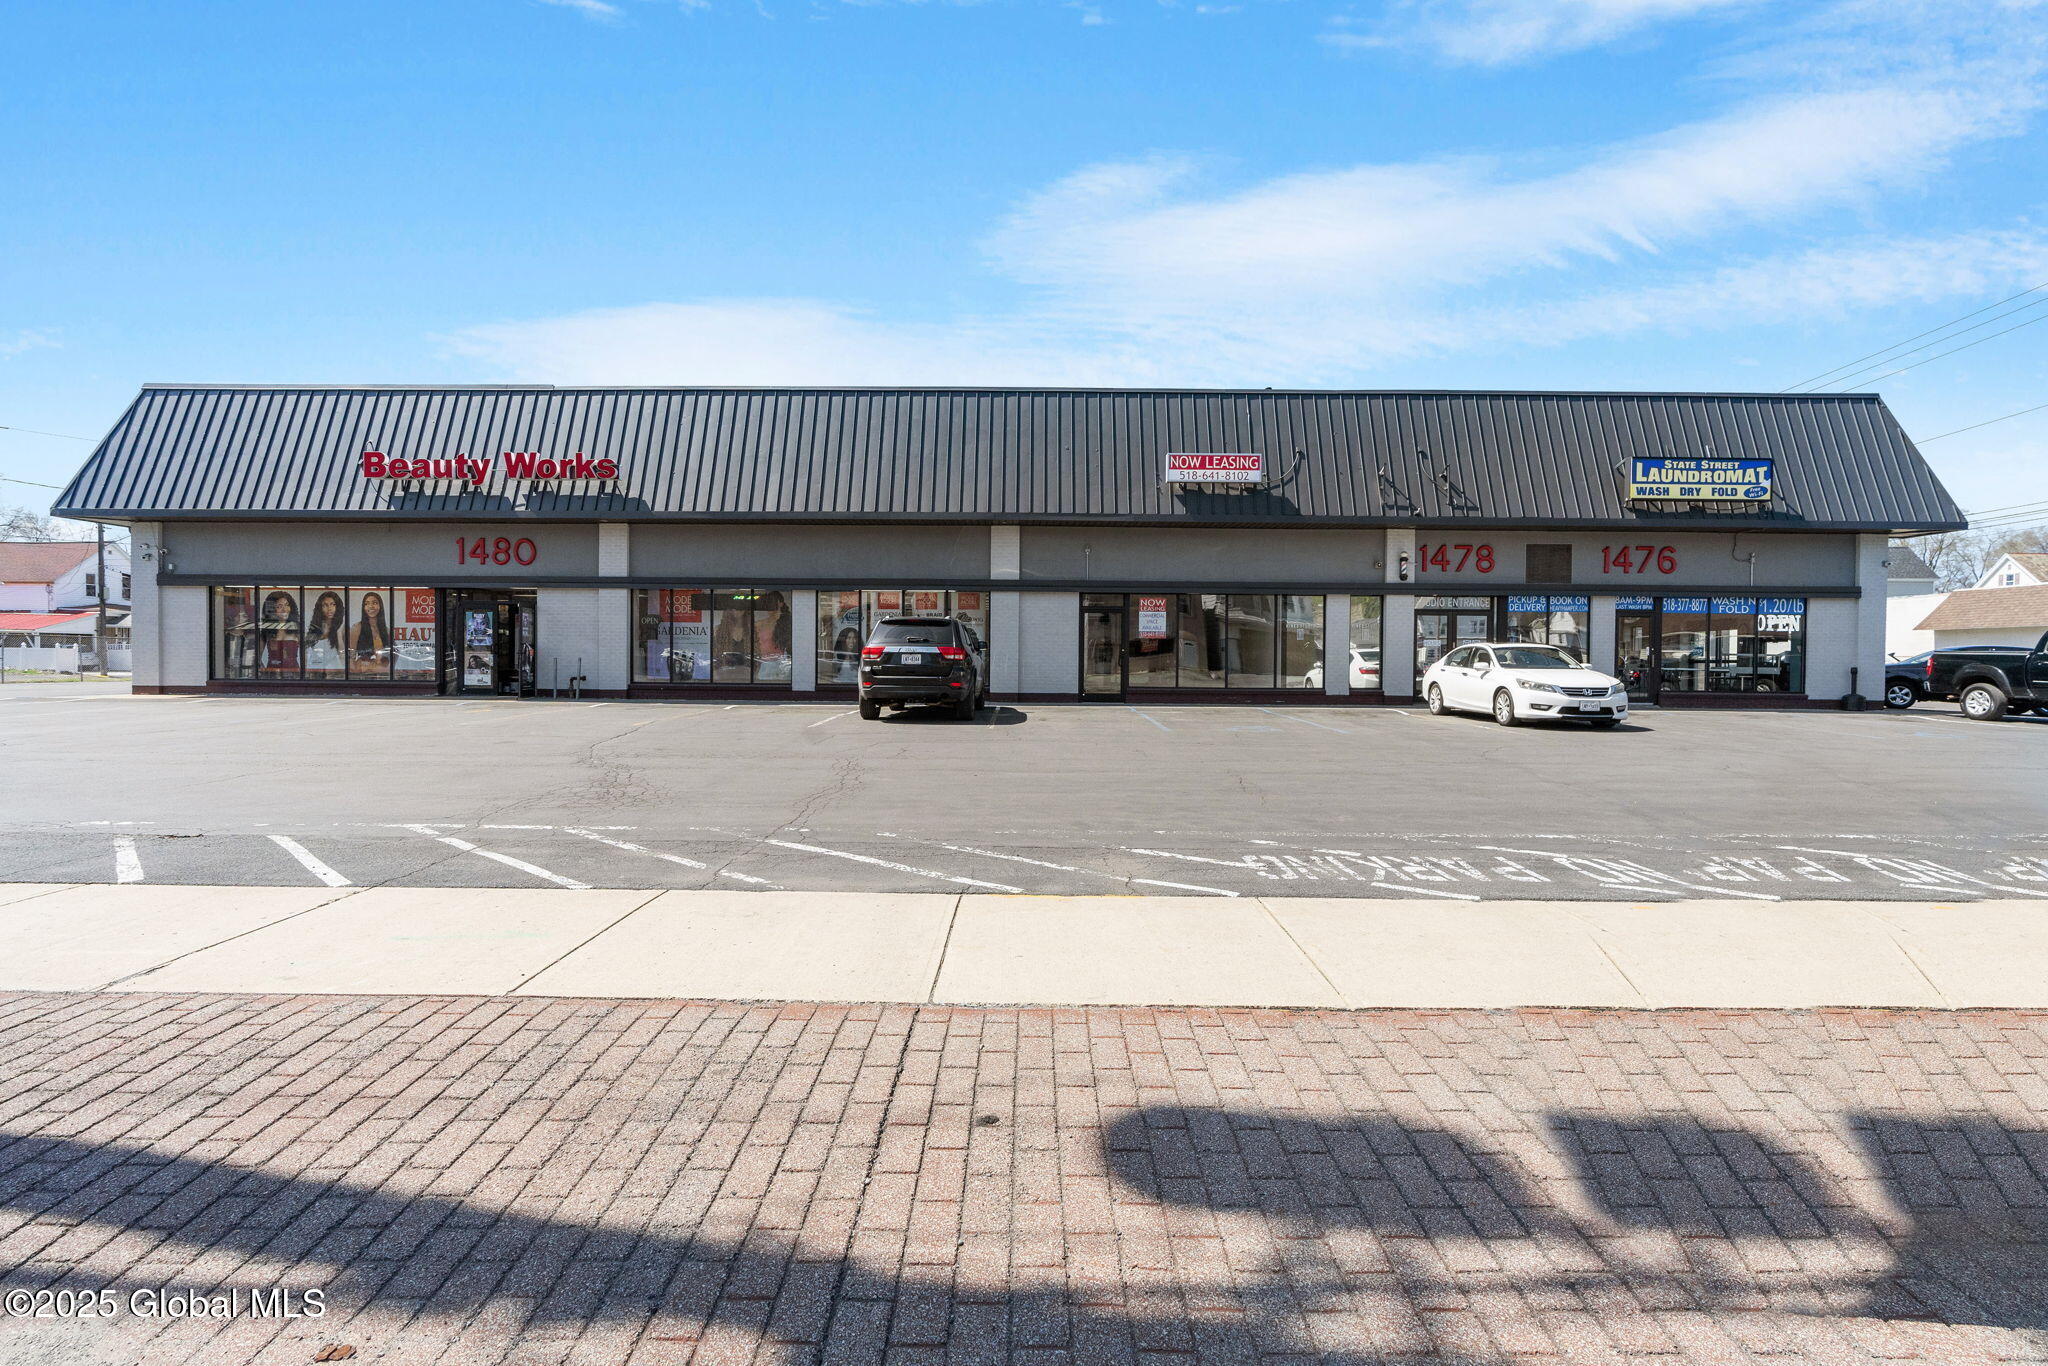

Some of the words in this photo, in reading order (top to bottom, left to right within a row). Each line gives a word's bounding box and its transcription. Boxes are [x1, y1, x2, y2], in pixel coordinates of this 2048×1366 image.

[1170, 455, 1201, 468] NOW
[1206, 456, 1258, 469] LEASING
[1664, 460, 1696, 469] STATE
[1701, 460, 1740, 469] STREET
[363, 451, 491, 486] Beauty
[504, 451, 619, 480] Works
[1636, 461, 1768, 483] LAUNDROMAT
[1180, 471, 1249, 480] 518-641-8102
[1636, 487, 1669, 496] WASH
[1680, 487, 1701, 497] DRY
[1711, 487, 1738, 497] FOLD
[455, 537, 537, 566] 1480
[1418, 544, 1496, 573] 1478
[1602, 545, 1677, 574] 1476
[412, 596, 435, 605] MOD
[1448, 598, 1490, 608] ENTRANCE
[1508, 596, 1538, 604] PICKUP
[1539, 596, 1546, 604] &
[1549, 596, 1573, 605] BOOK
[1575, 596, 1588, 605] ON
[1615, 596, 1654, 604] 8AM-9PM
[1663, 598, 1708, 611] 518-377-8877
[1712, 597, 1744, 605] WASH
[1746, 597, 1756, 606] N
[412, 605, 435, 614] MOD
[1508, 603, 1547, 612] DELIVERY
[1719, 605, 1749, 613] FOLD
[641, 617, 659, 625] OPEN
[1757, 614, 1802, 632] OPEN
[393, 627, 436, 641] HAU
[658, 627, 707, 635] ADENIA
